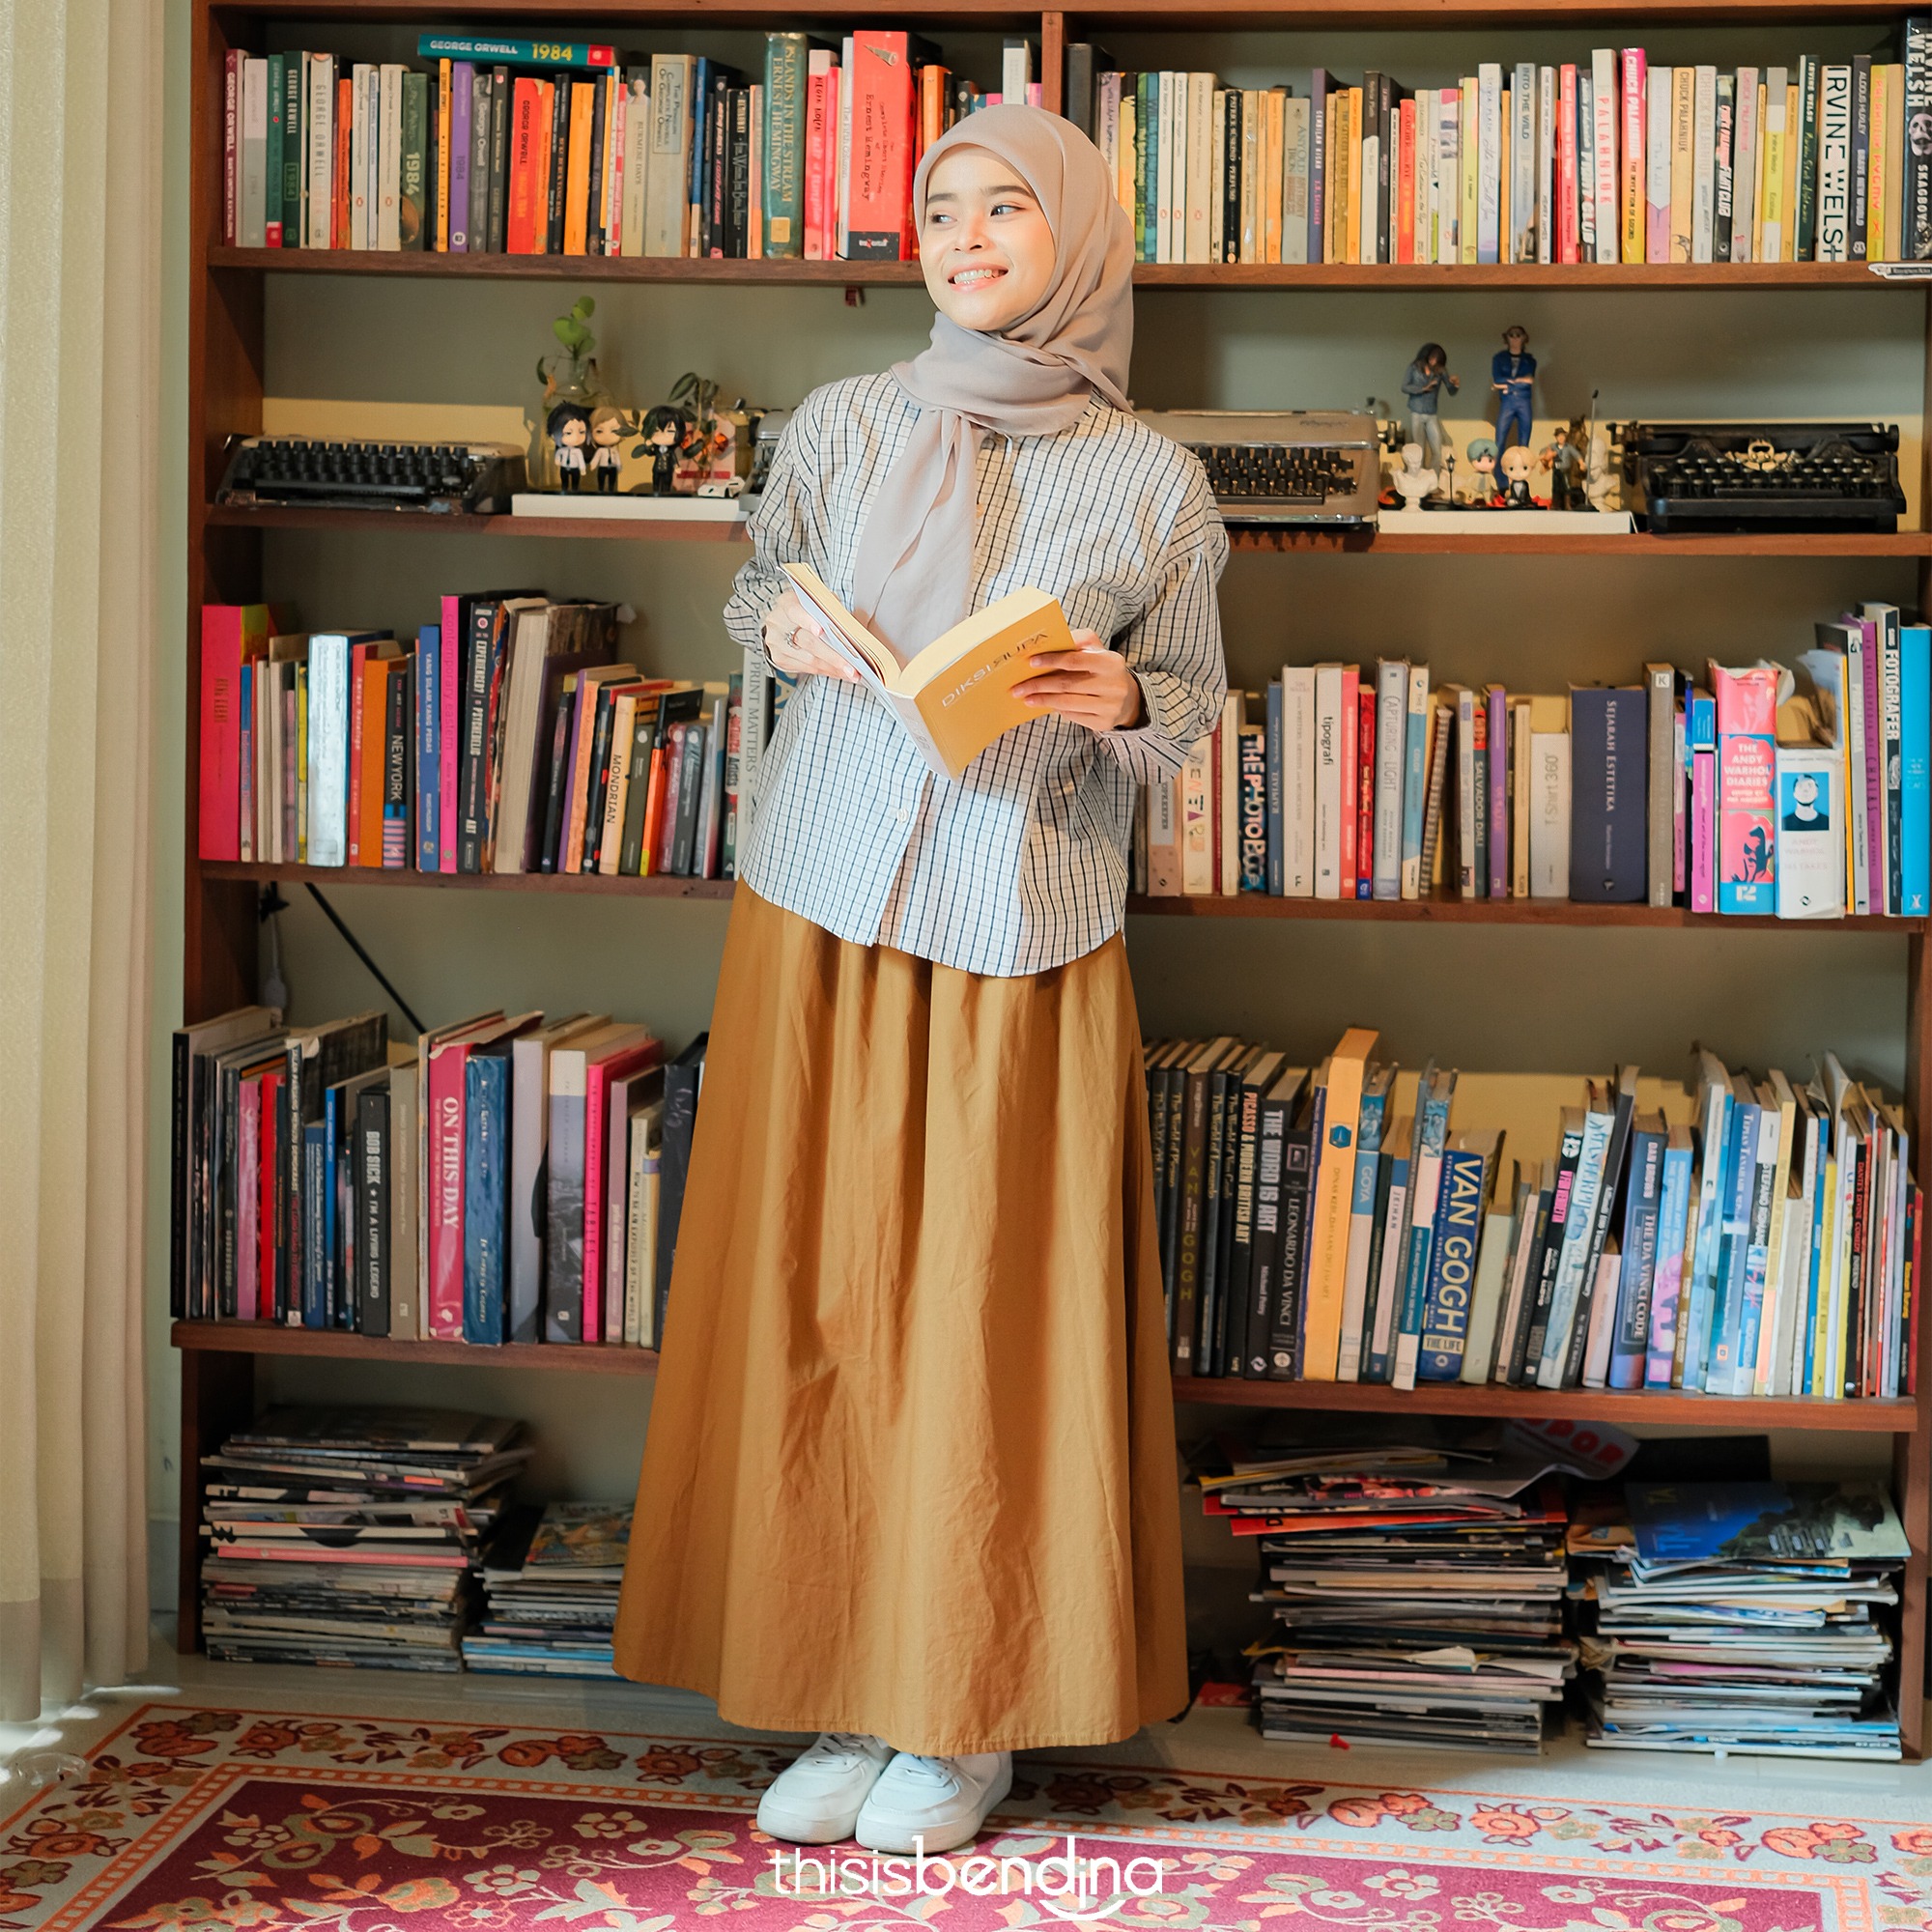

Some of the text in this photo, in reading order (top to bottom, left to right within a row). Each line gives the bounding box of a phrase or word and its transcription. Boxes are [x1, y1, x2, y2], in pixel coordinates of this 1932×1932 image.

[431, 40, 519, 55] GEORGE ORWELL
[532, 43, 573, 61] 1984
[659, 69, 667, 81] OF
[1907, 33, 1924, 107] WELSH
[226, 72, 235, 152] GEORGE ORWELL
[286, 70, 297, 134] GEORGE ORWELL
[843, 105, 852, 122] The
[1521, 67, 1530, 140] INTO THE WILD
[1625, 55, 1640, 159] CHUCK PALAHNIUK
[1677, 71, 1690, 154] CHUCK PALAHNIUK
[1805, 62, 1815, 123] IRVINE WELSH
[1825, 67, 1847, 160] IRVINE
[1857, 71, 1867, 135] ALDOUS HUXLEY
[314, 84, 326, 177] GEORGE ORWELL
[476, 102, 488, 168] George Orwell
[770, 58, 783, 193] ERNEST HEMINGWAY
[781, 46, 795, 203] ISLANDS IN THE STREAM
[861, 94, 874, 201] Ernest Hemingway
[876, 101, 889, 194] Complete Short Stories
[1597, 97, 1611, 205] PALAHNIUK
[406, 152, 420, 196] 1984
[455, 156, 465, 182] 1984
[635, 122, 644, 185] BURMESE DAYS
[1288, 148, 1297, 173] IRON
[1855, 149, 1865, 227] BRAVE NEW WORLD
[1871, 153, 1882, 211] PYGMY
[1580, 199, 1596, 244] CLUB
[441, 612, 456, 750] contemporary eastern
[1658, 676, 1666, 686] K
[1886, 648, 1899, 741] FOTOGRAFER
[745, 661, 761, 773] PRINT MATTERS
[1320, 716, 1335, 766] tipografi
[1382, 695, 1400, 752] CAPTURING
[390, 735, 404, 801] NEW YORK
[725, 756, 740, 787] Artists
[1242, 734, 1264, 773] THE
[1383, 761, 1397, 790] LIGHT
[1605, 699, 1617, 811] SEJARAH ESTETIKA
[1724, 765, 1771, 775] WARHOL
[1732, 754, 1763, 764] ANDY
[1738, 744, 1758, 753] THE
[605, 753, 623, 824] MONDRIAN
[1243, 774, 1264, 839] PHOTO
[1474, 759, 1484, 846] SALVADOR DALI
[1725, 777, 1769, 787] DIARIES
[465, 818, 476, 835] ART
[1169, 1113, 1180, 1140] World
[1172, 1093, 1181, 1113] The
[1241, 1092, 1257, 1133] PICASSO
[366, 1130, 380, 1154] BOB
[366, 1155, 380, 1184] SICK
[442, 1096, 459, 1230] ON THIS DAY
[1168, 1141, 1178, 1152] of
[1208, 1094, 1222, 1200] The World of Leonardo
[1237, 1143, 1254, 1183] MODERN
[1256, 1109, 1282, 1235] THE WORD IS ART
[1359, 1165, 1374, 1204] GOYA
[1855, 1161, 1864, 1192] DANTE'S
[585, 1201, 595, 1254] TABLES
[1236, 1184, 1252, 1223] BRITISH
[1390, 1191, 1401, 1230] JEIHAN
[1855, 1194, 1863, 1219] DIVINE
[1235, 1223, 1249, 1244] ART
[1435, 1158, 1481, 1333] VAN GOGH
[1853, 1221, 1861, 1253] COMEDY
[369, 1261, 378, 1298] LEGEND
[1279, 1197, 1301, 1326] LEONARDO DA VINCI
[1634, 1213, 1655, 1339] THE DA VINCI CODE
